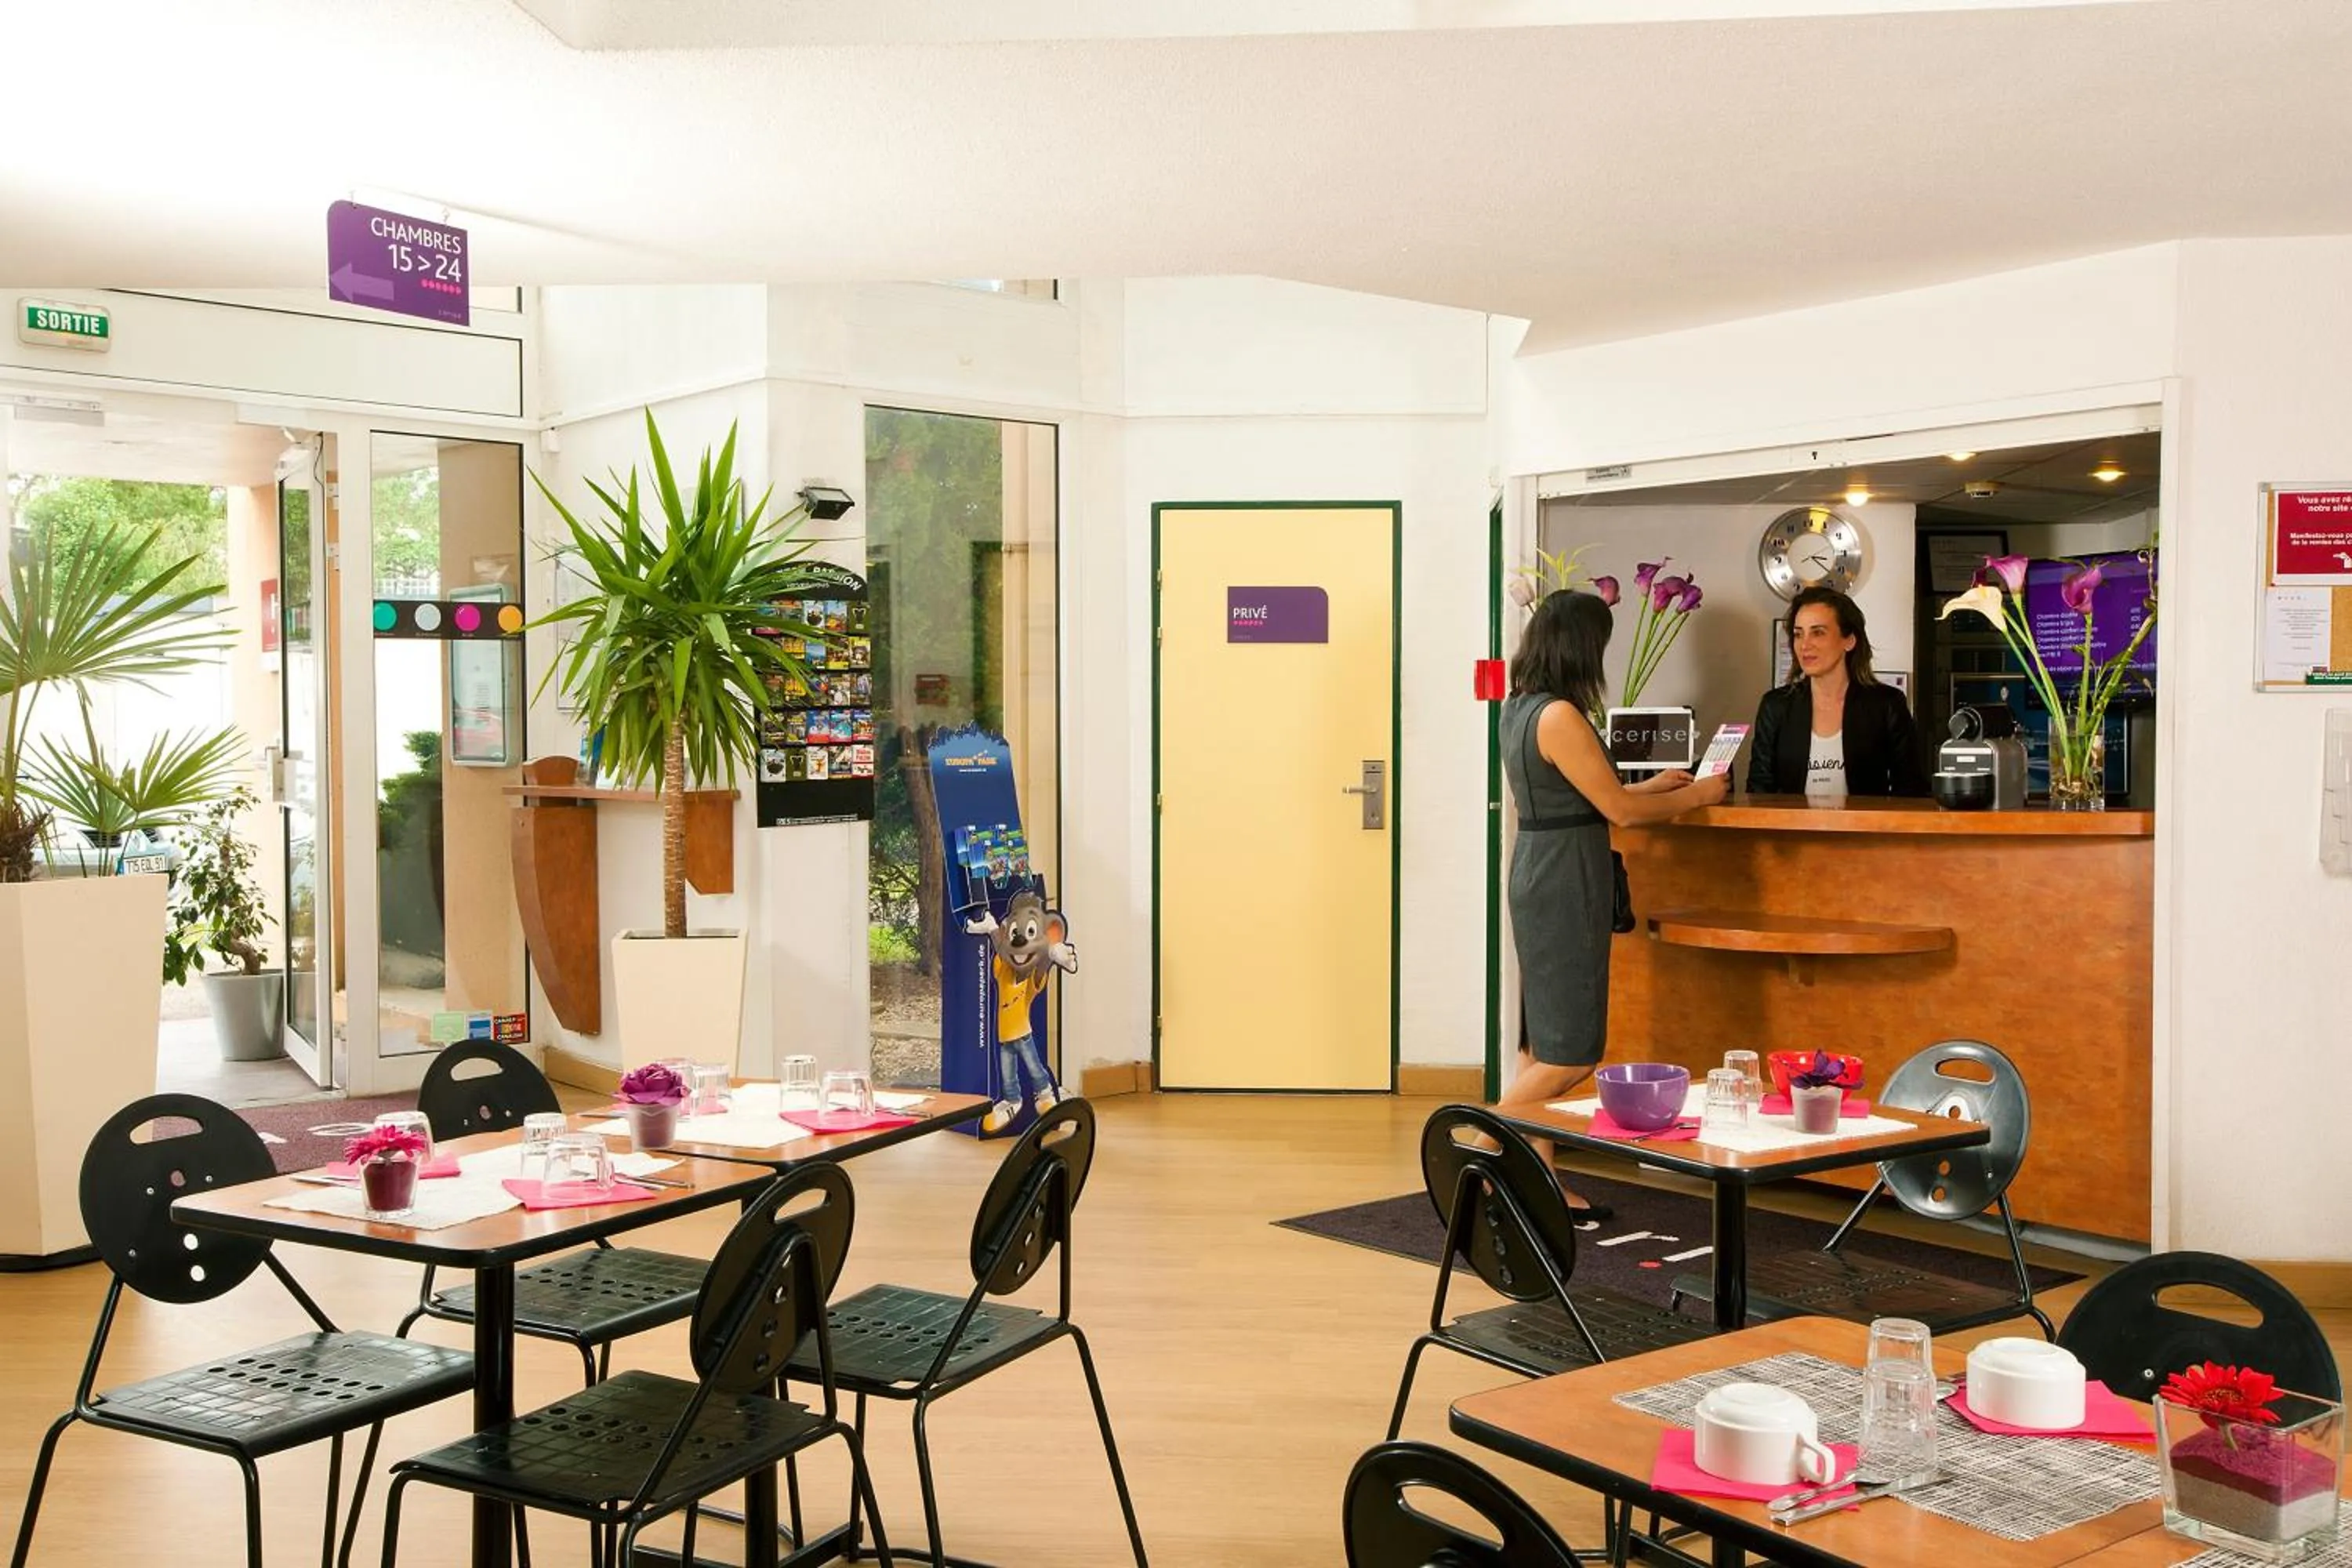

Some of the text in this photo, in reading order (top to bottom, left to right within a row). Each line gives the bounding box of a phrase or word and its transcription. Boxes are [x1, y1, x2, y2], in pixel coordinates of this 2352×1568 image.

[370, 216, 462, 255] CHAMBRES
[388, 244, 412, 272] 15
[435, 254, 462, 283] 24
[36, 309, 100, 335] SORTIE
[2296, 495, 2318, 504] Vous
[1232, 604, 1268, 619] PRIVÉ
[1612, 728, 1686, 742] cerise
